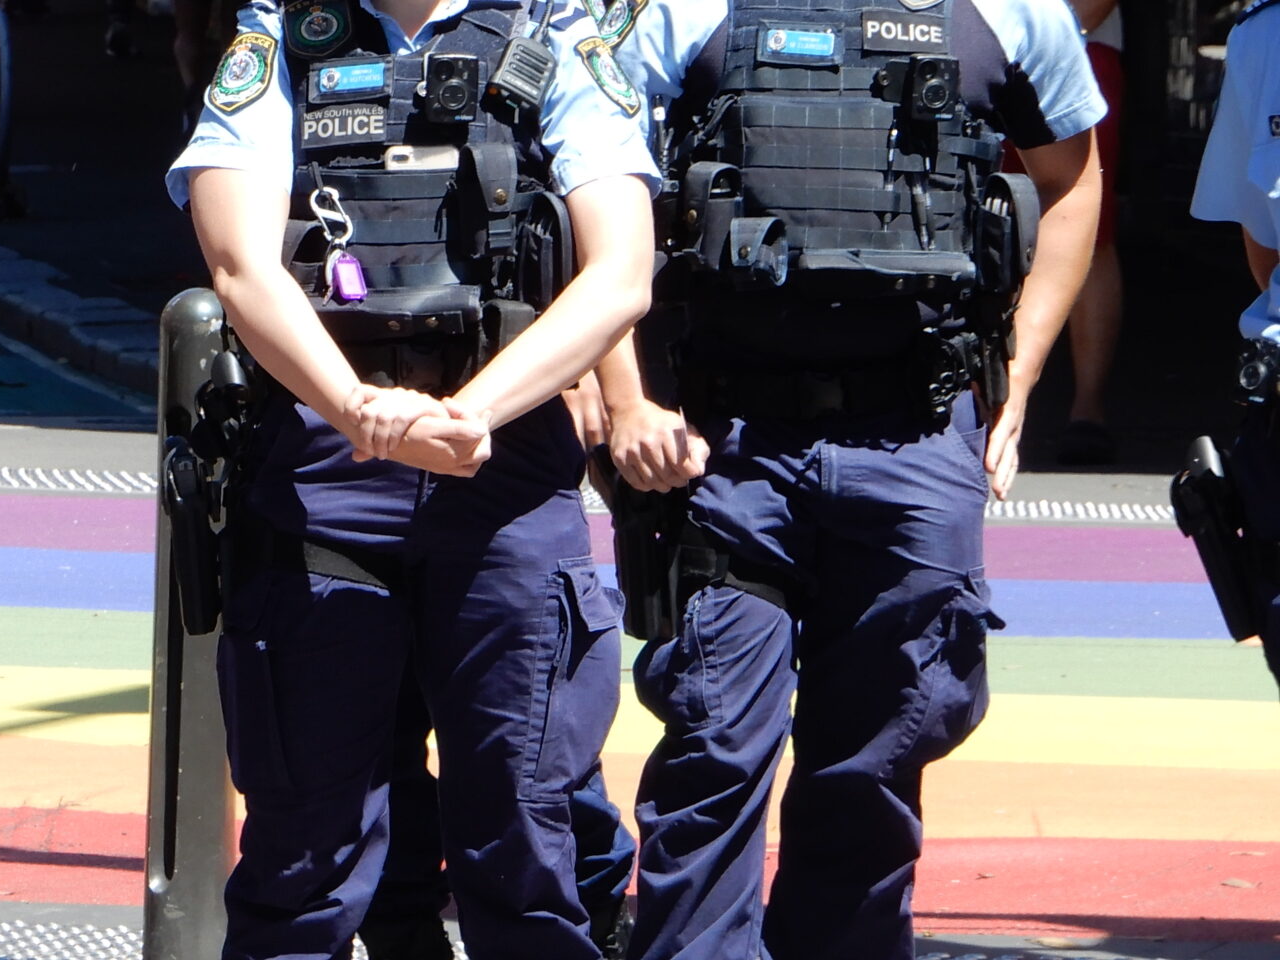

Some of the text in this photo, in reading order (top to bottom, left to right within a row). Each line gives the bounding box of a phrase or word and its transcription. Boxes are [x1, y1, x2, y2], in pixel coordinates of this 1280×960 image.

[866, 20, 943, 43] POLICE
[303, 106, 384, 121] NEW SOUTH WALES
[303, 115, 385, 140] POLICE
